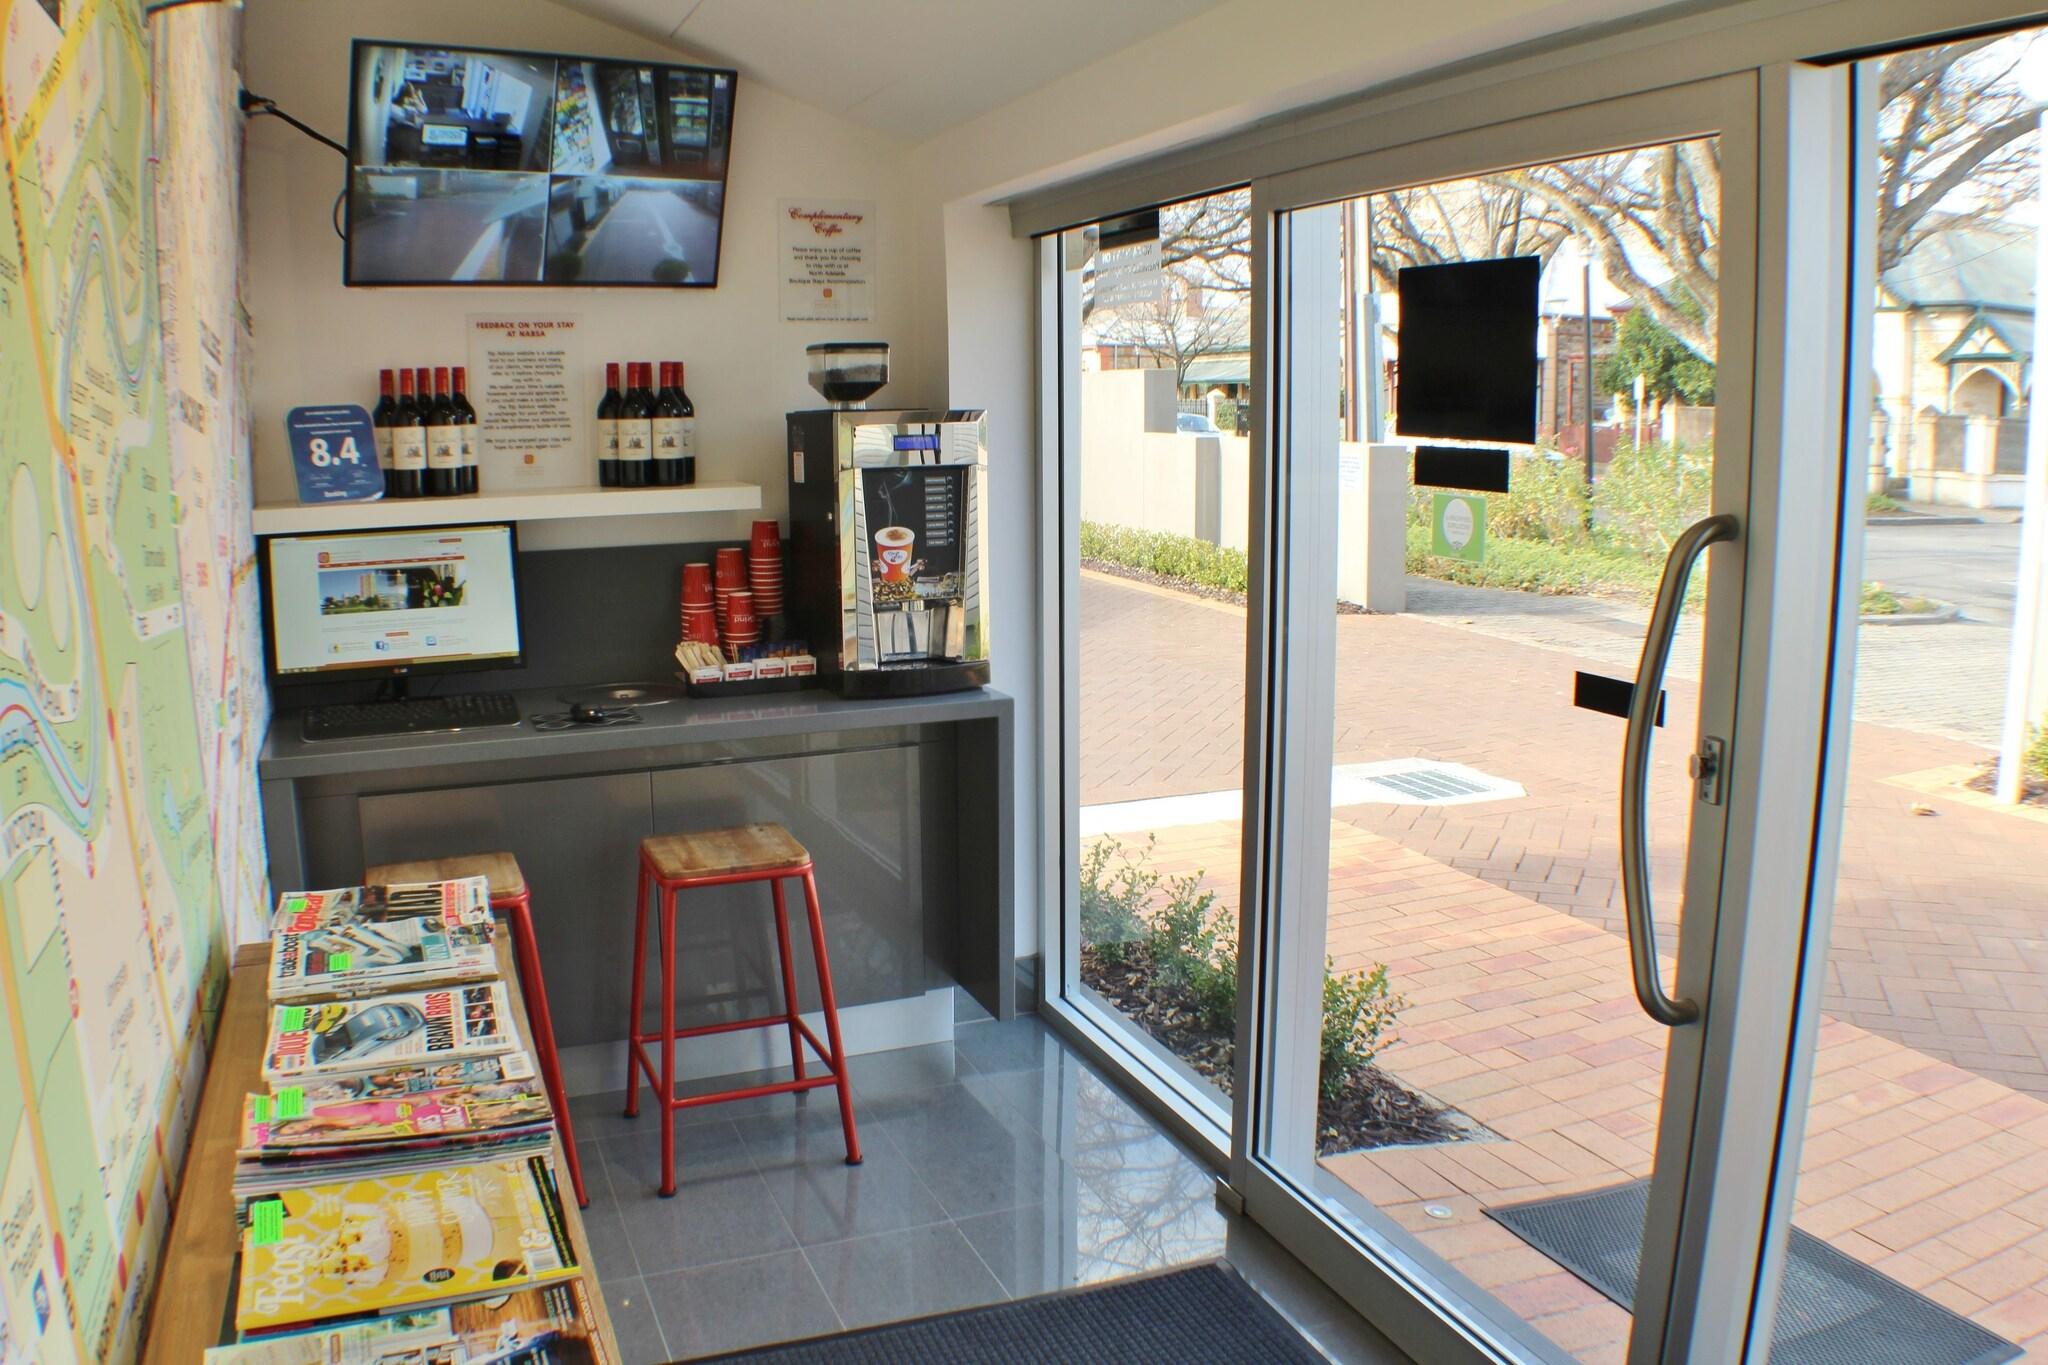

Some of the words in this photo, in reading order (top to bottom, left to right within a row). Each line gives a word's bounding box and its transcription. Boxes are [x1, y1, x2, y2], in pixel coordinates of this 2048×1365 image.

[788, 207, 863, 224] Complimentary
[813, 222, 842, 237] Coffee
[476, 321, 514, 329] FEEDBACK
[518, 321, 530, 329] ON
[533, 321, 554, 329] YOUR
[557, 321, 575, 329] STAY
[309, 436, 360, 467] 8.4
[424, 992, 451, 1017] BROS
[426, 1016, 454, 1052] BRAWN
[256, 1235, 320, 1316] Feast
